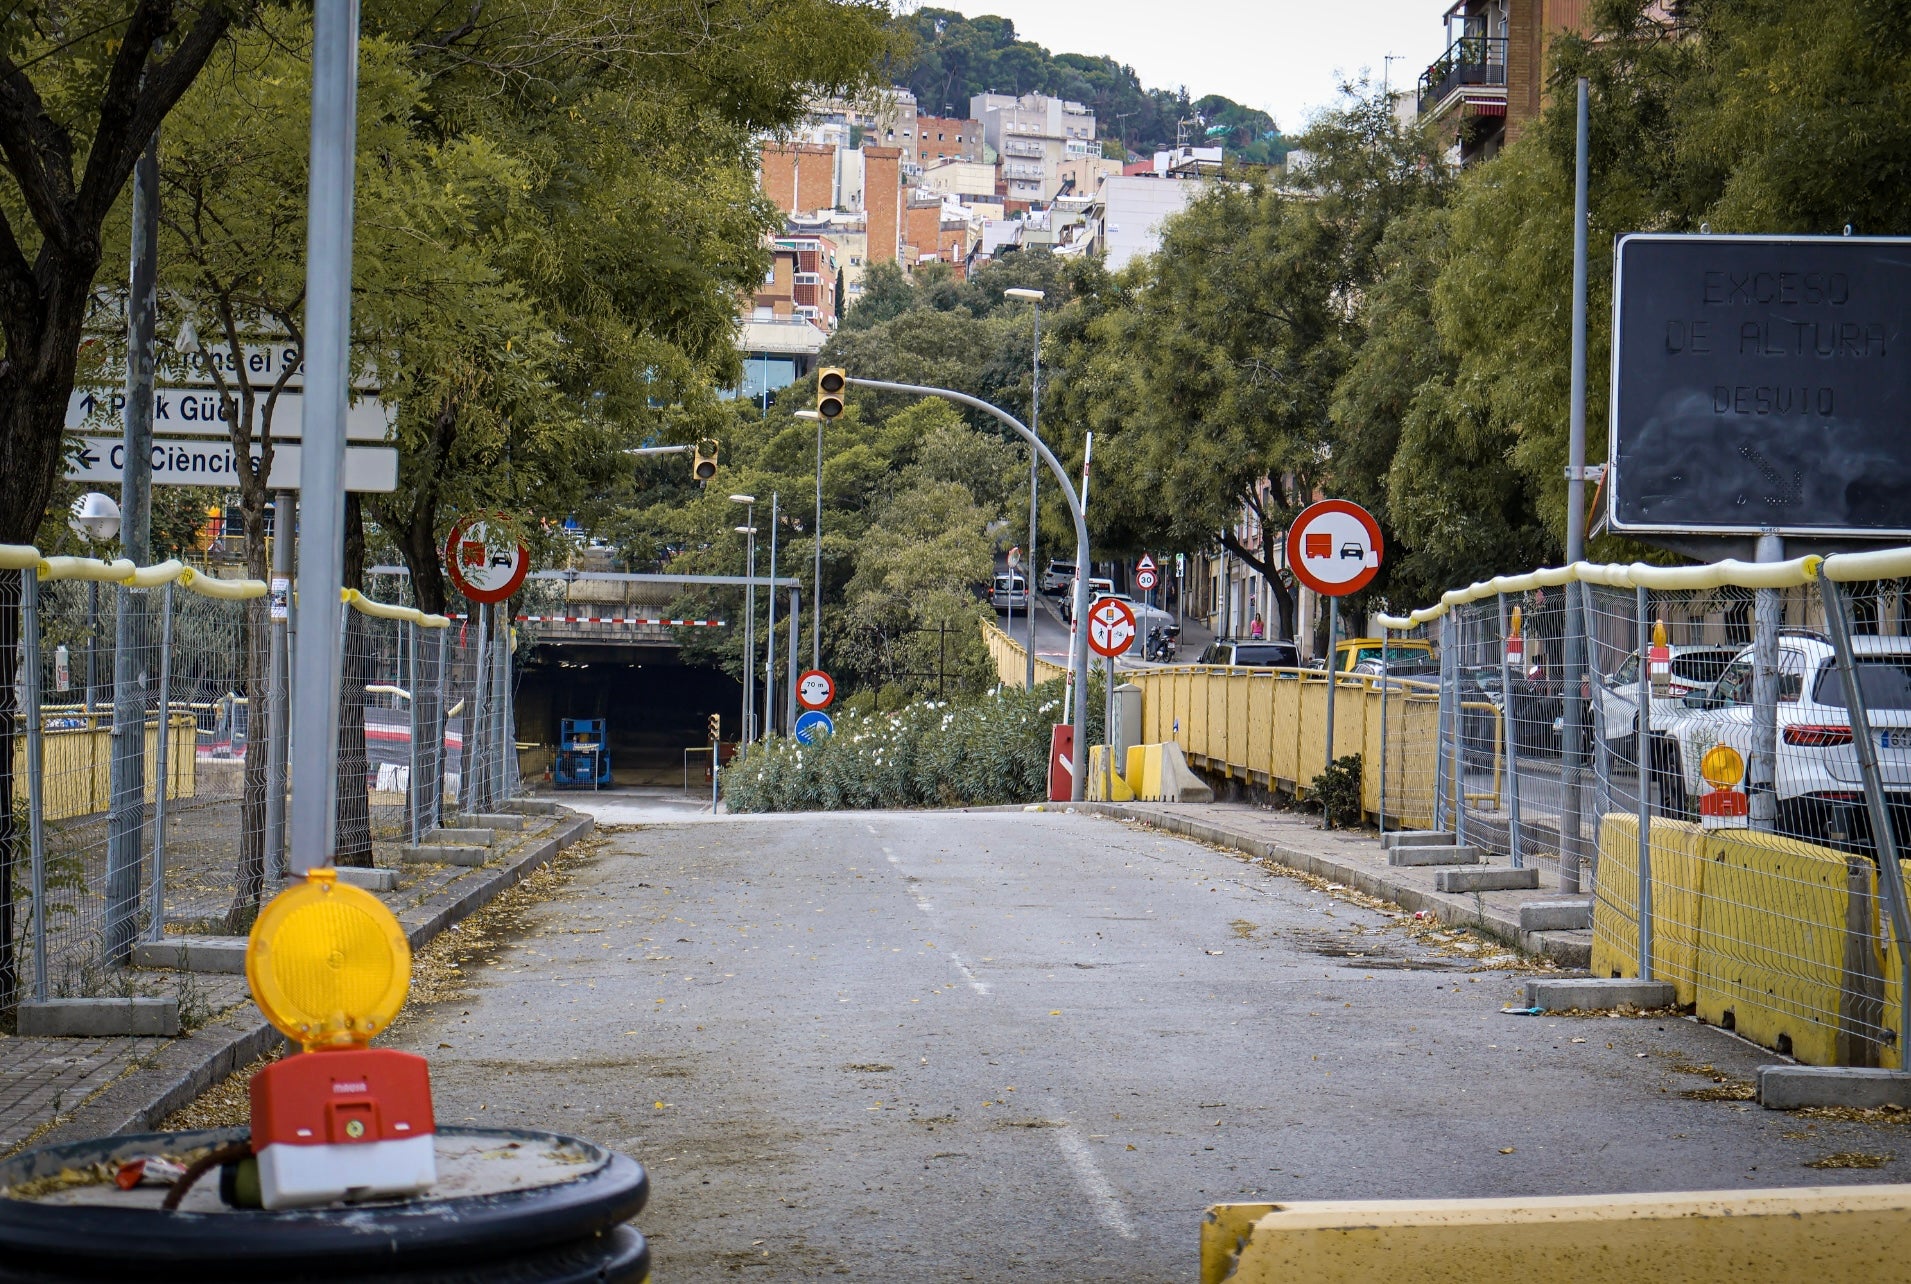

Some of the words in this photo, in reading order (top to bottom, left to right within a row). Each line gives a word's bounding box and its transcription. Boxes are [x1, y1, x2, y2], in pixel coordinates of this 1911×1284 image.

[1703, 271, 1849, 305] EXCESO
[1665, 320, 1711, 354] DE
[1740, 321, 1887, 357] ALTURA
[111, 394, 170, 420] Pk
[1713, 386, 1835, 417] DESVIO
[1140, 576, 1152, 584] 30
